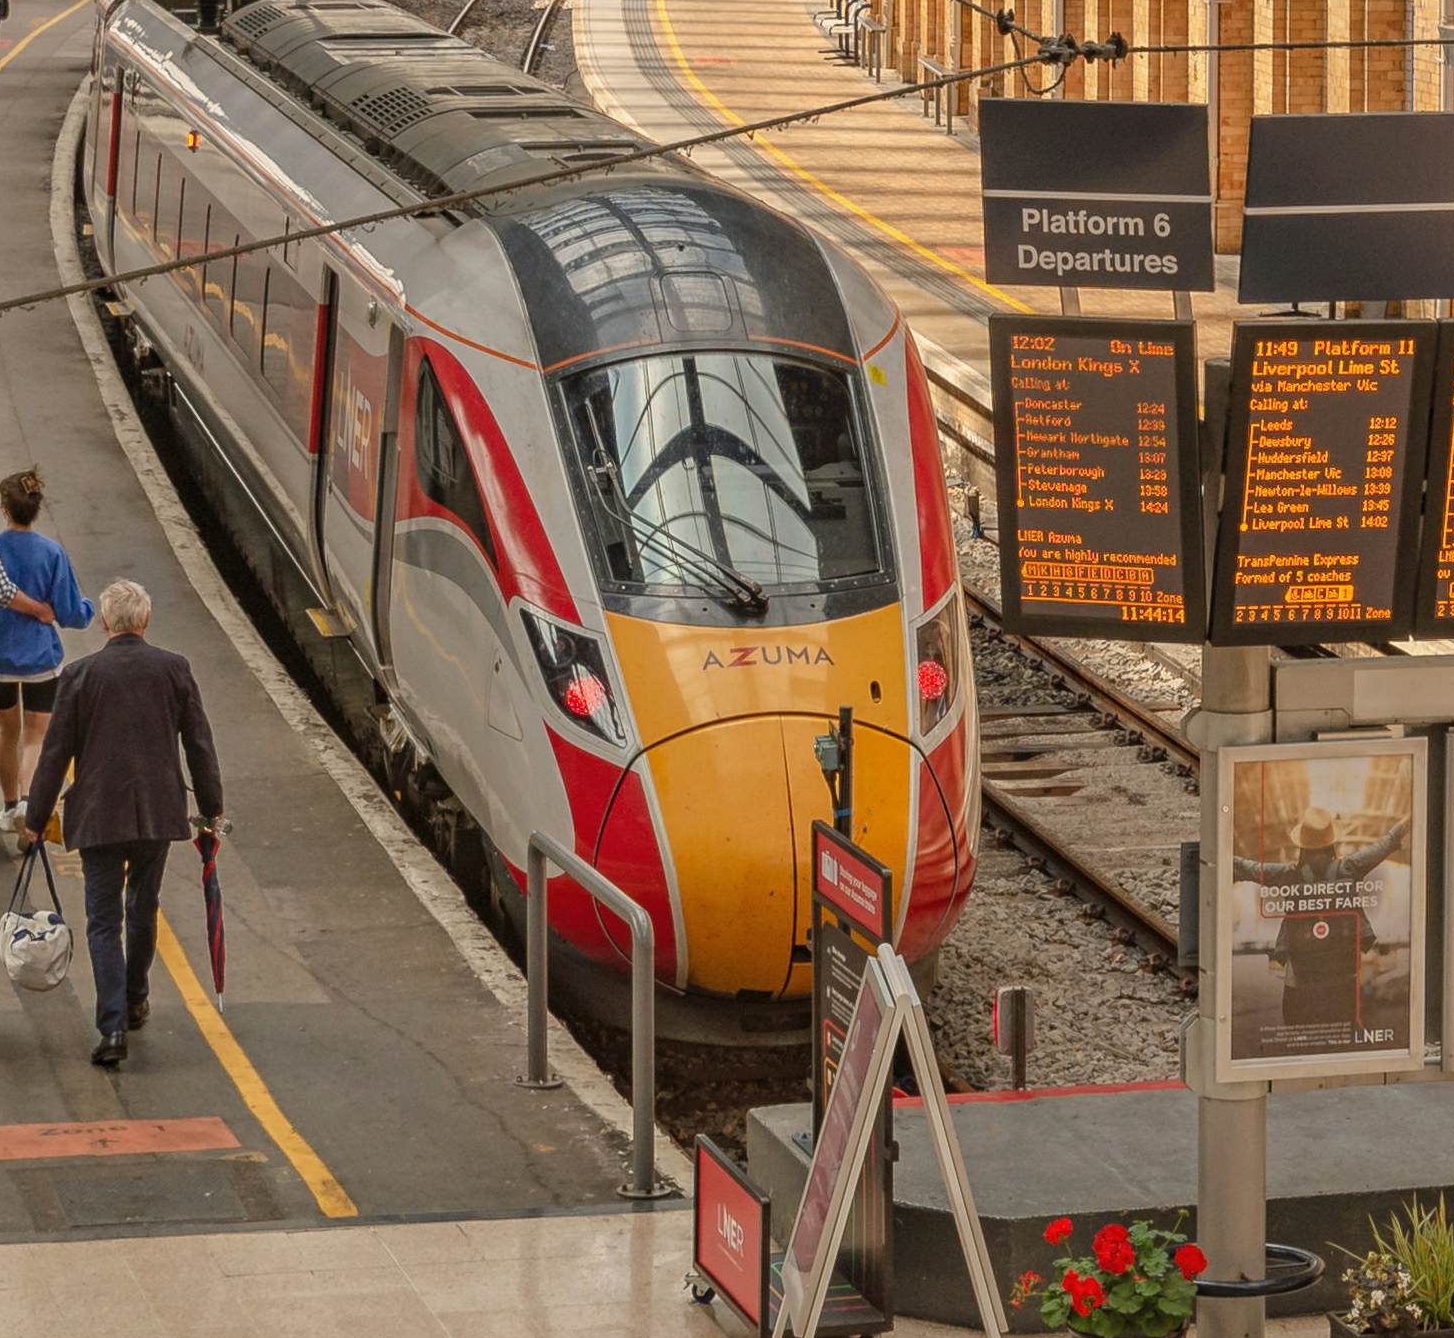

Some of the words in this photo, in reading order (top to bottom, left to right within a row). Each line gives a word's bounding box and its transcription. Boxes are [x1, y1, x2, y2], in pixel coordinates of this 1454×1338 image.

[1022, 208, 1144, 236] Platform
[1154, 213, 1170, 237] 6
[1018, 245, 1178, 276] Departures
[1256, 342, 1298, 357] 11:49
[1314, 341, 1391, 356] Platform
[1398, 340, 1414, 355] 11
[1011, 355, 1072, 371] London
[1077, 357, 1123, 376] Kings
[1129, 360, 1140, 373] X
[1253, 361, 1333, 379] Liverpool
[1339, 361, 1374, 375] Lime
[1380, 360, 1399, 374] St
[1252, 381, 1272, 393] via
[1278, 381, 1351, 392] Manchester
[1357, 379, 1378, 391] Vic
[1121, 606, 1185, 623] 11:44:14
[702, 646, 834, 671] AZUMA
[1260, 885, 1300, 898] BOOK
[1303, 882, 1352, 896] DIRECT
[1356, 880, 1384, 892] FOR
[1265, 900, 1294, 912] OUR
[1298, 899, 1331, 911] BEST
[1335, 896, 1378, 908] FARES
[1355, 1029, 1394, 1044] LNER
[717, 1203, 744, 1257] LNER
